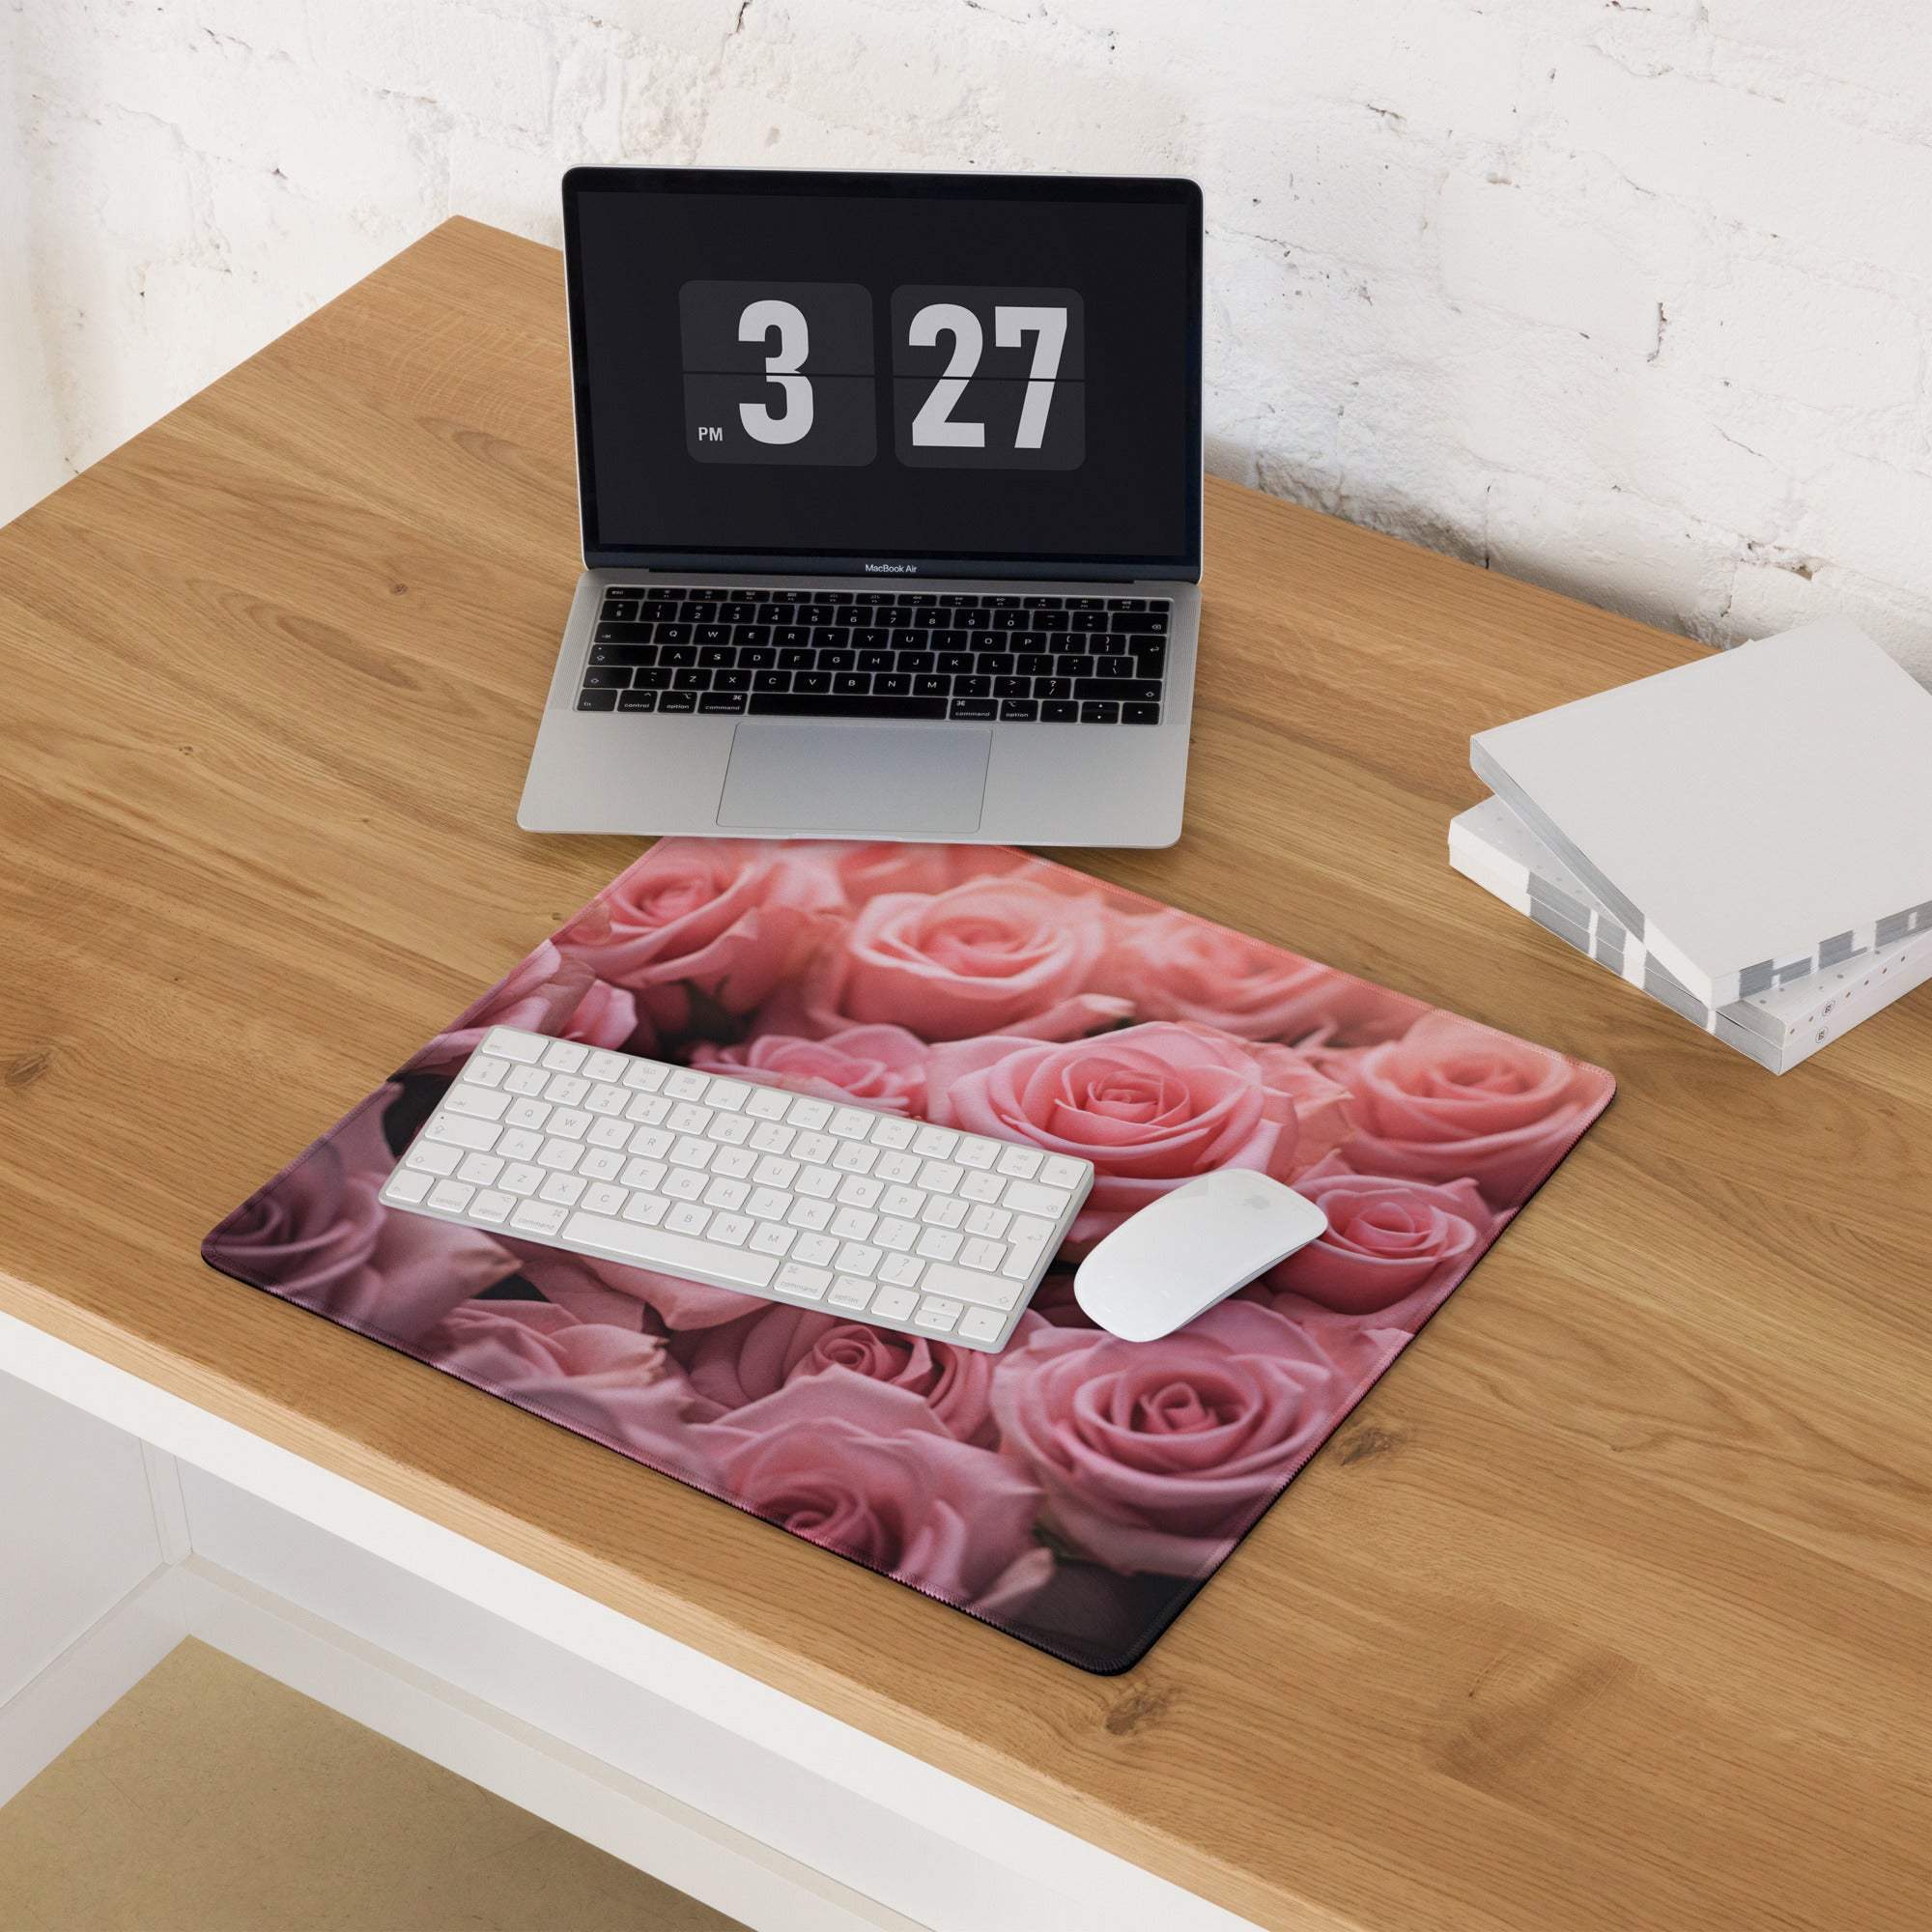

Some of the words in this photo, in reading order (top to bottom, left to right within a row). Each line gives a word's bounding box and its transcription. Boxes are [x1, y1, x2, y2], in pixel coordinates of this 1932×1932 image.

[738, 299, 813, 444] 3
[908, 303, 1067, 448] 27
[697, 426, 724, 441] PM
[865, 563, 903, 573] MacBook
[905, 564, 918, 573] Air
